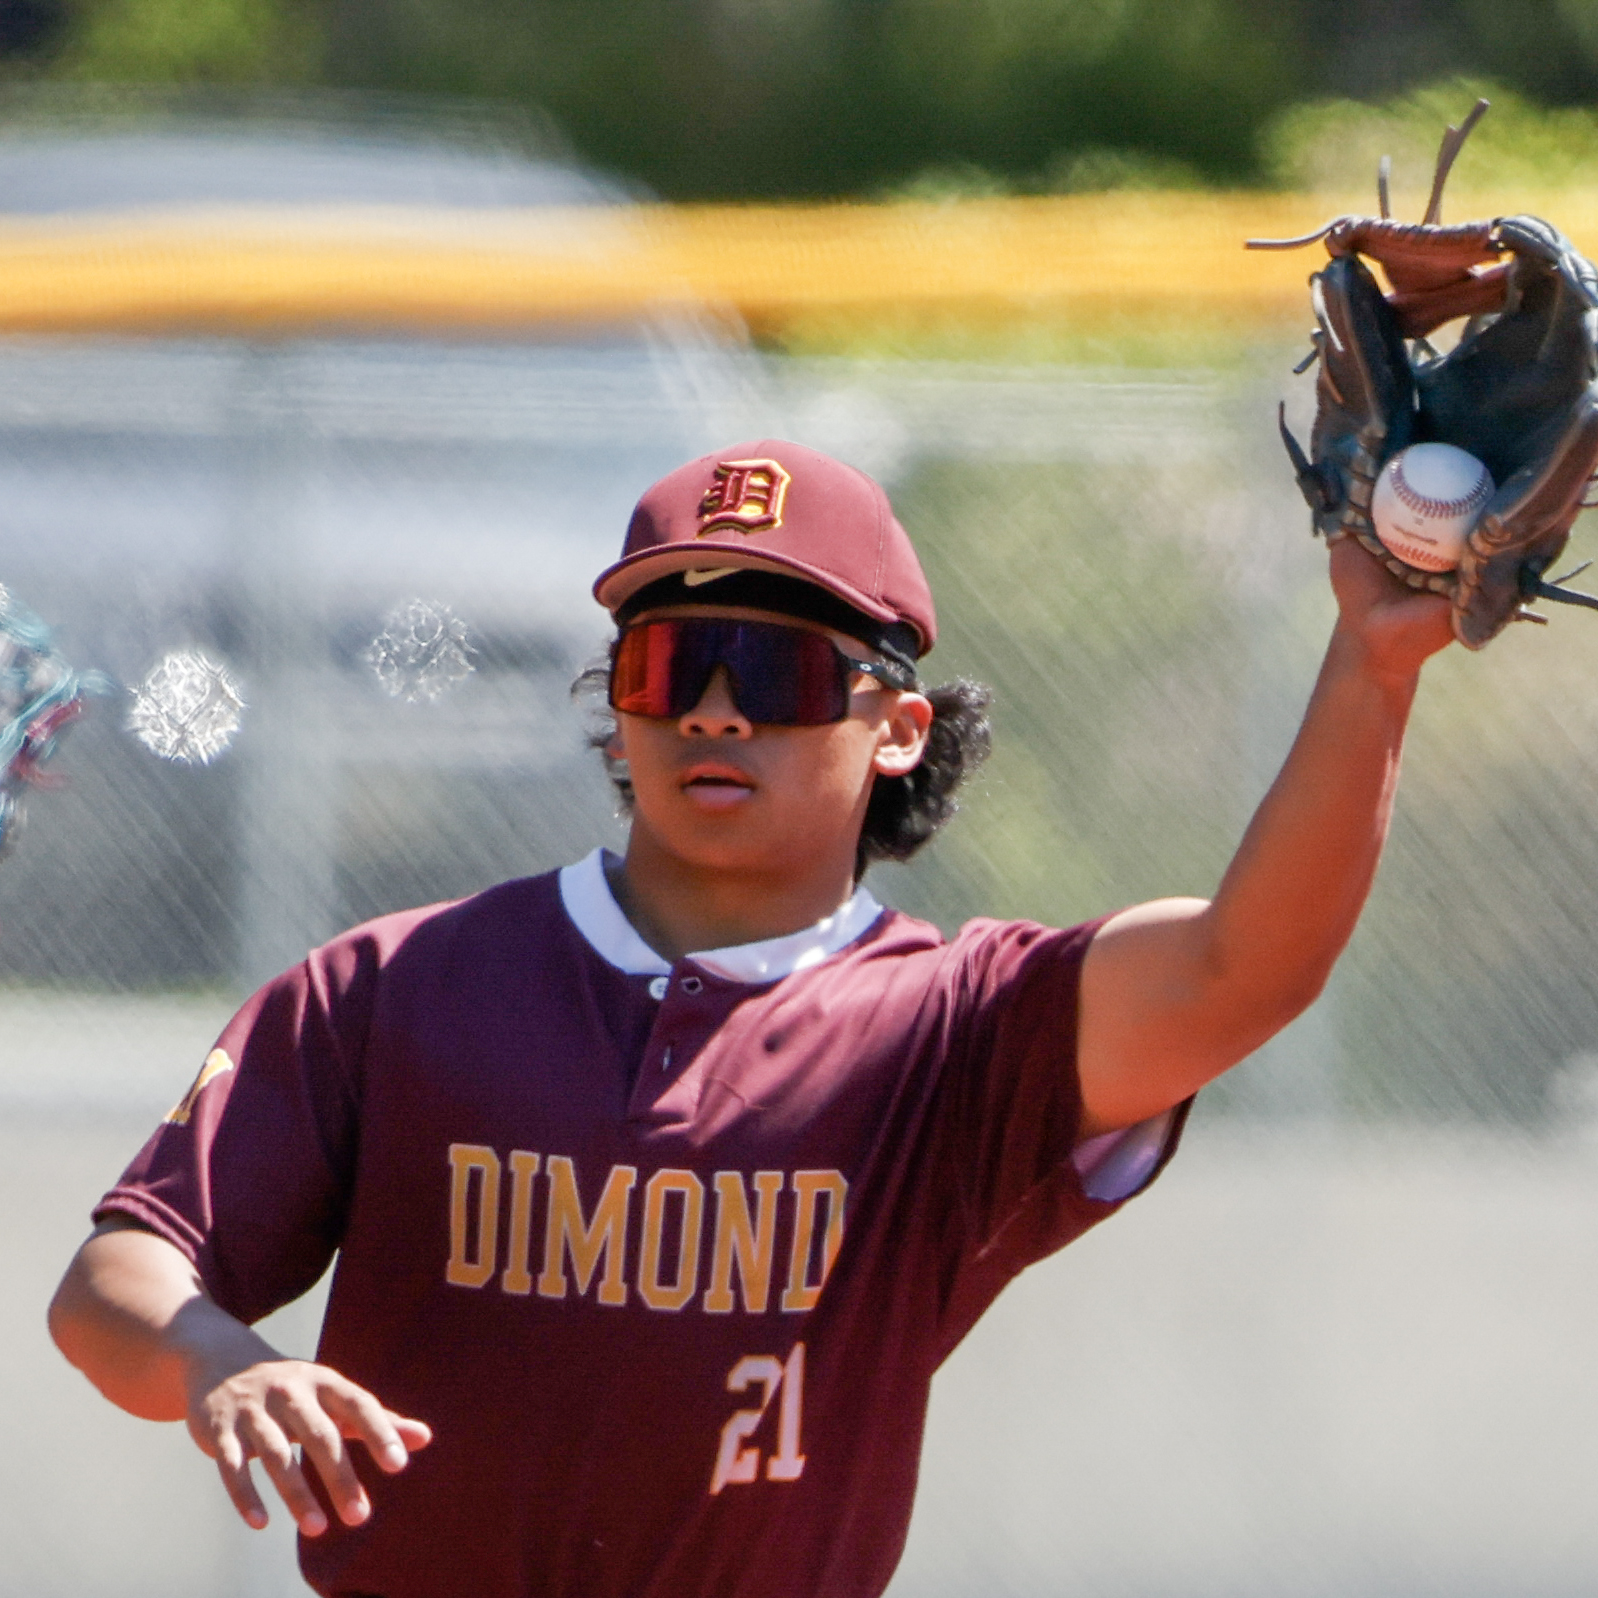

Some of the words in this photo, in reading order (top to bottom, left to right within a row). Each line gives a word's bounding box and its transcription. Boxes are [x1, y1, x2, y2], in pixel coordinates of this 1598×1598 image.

[696, 458, 791, 540] D
[446, 1143, 849, 1313] DIMOND
[708, 1341, 806, 1495] 21
